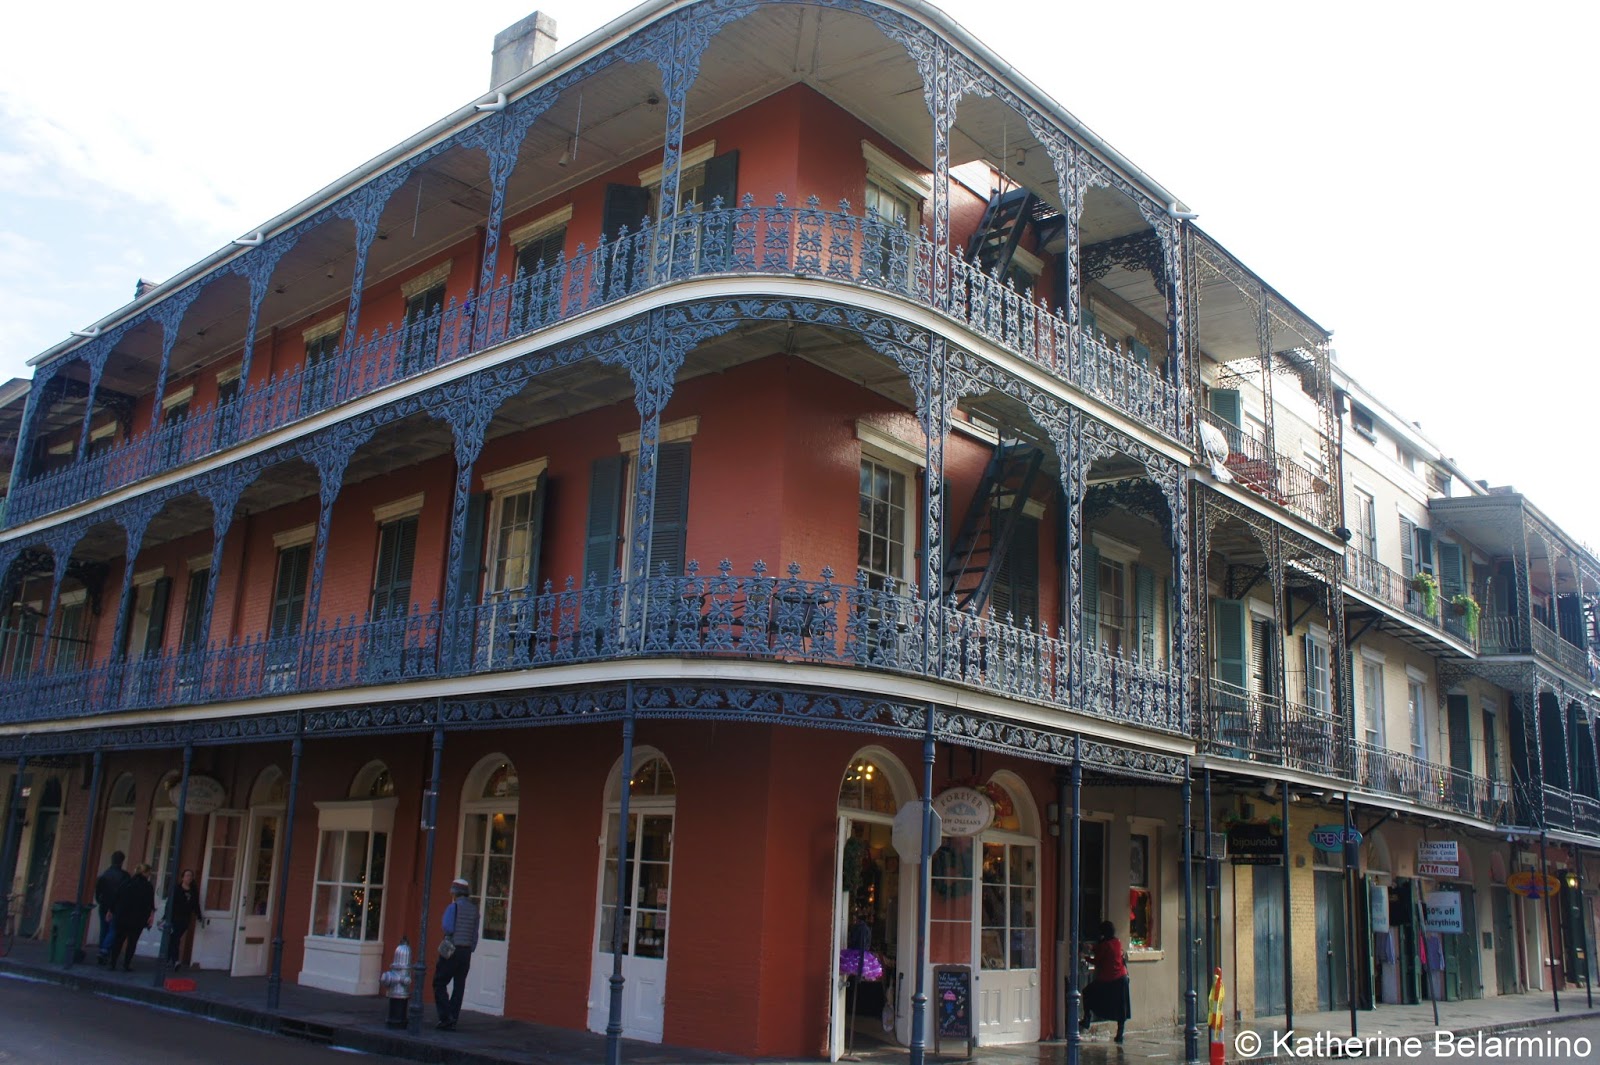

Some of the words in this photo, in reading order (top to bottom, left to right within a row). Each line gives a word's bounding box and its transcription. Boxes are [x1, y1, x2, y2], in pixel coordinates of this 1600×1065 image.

[941, 792, 983, 809] FOREVER
[1420, 864, 1439, 874] ATM
[1440, 866, 1457, 875] INSIDE
[1425, 918, 1460, 928] verything
